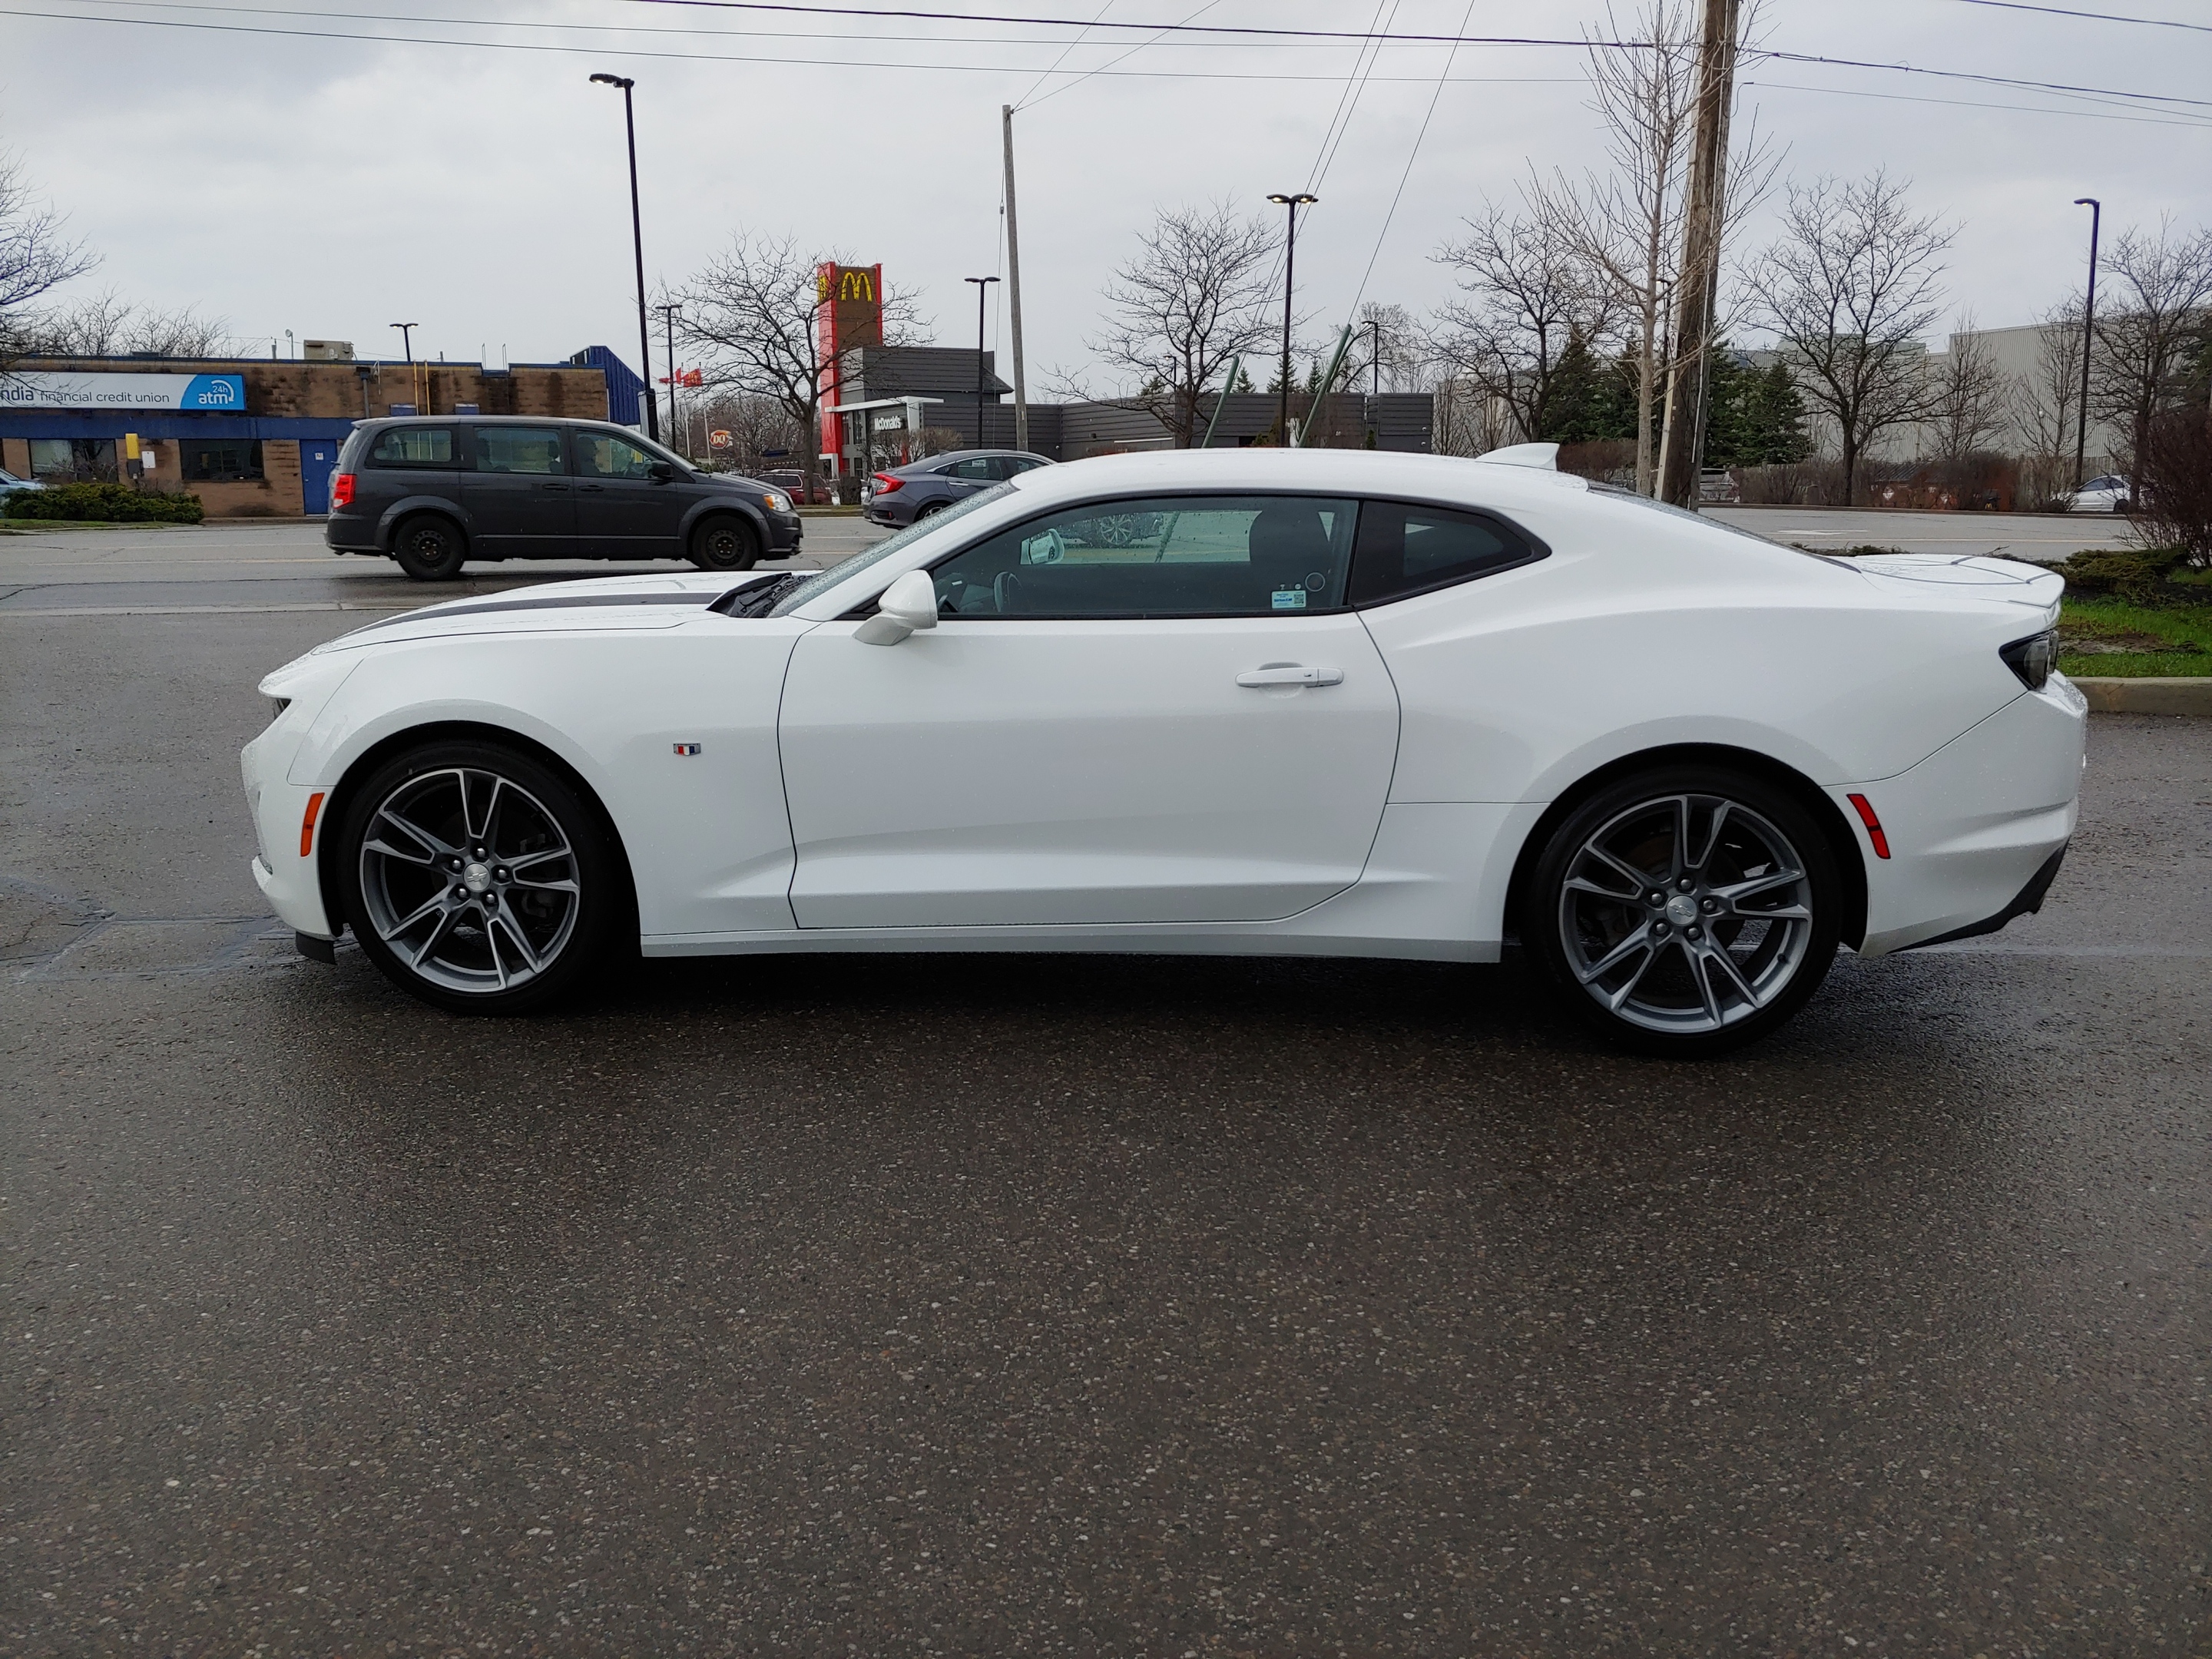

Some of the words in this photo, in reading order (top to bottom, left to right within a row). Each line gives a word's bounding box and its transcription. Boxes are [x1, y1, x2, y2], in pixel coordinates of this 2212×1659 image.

[212, 385, 228, 393] 24h
[96, 392, 132, 402] credit
[135, 392, 170, 402] union
[198, 392, 228, 404] atm
[713, 434, 726, 445] DQ
